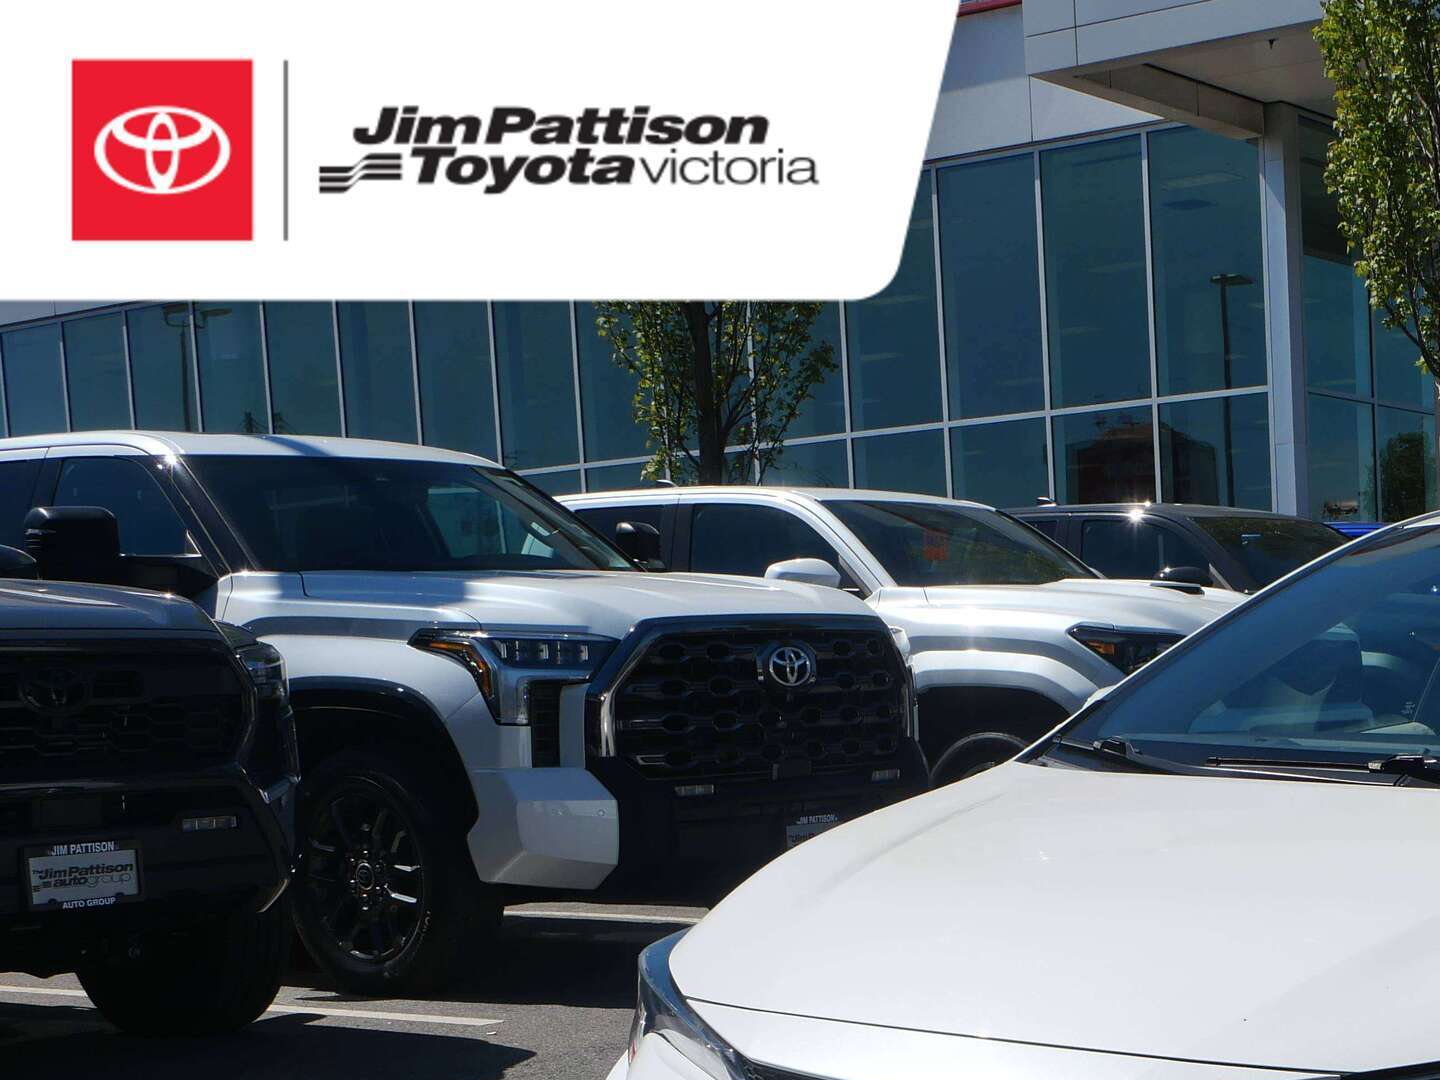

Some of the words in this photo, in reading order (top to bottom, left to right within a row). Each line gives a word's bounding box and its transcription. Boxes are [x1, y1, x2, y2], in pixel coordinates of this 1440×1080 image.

[51, 845, 68, 856] JIM
[70, 841, 115, 854] PATTISON
[62, 899, 86, 909] AUTO
[86, 896, 116, 907] GROUP
